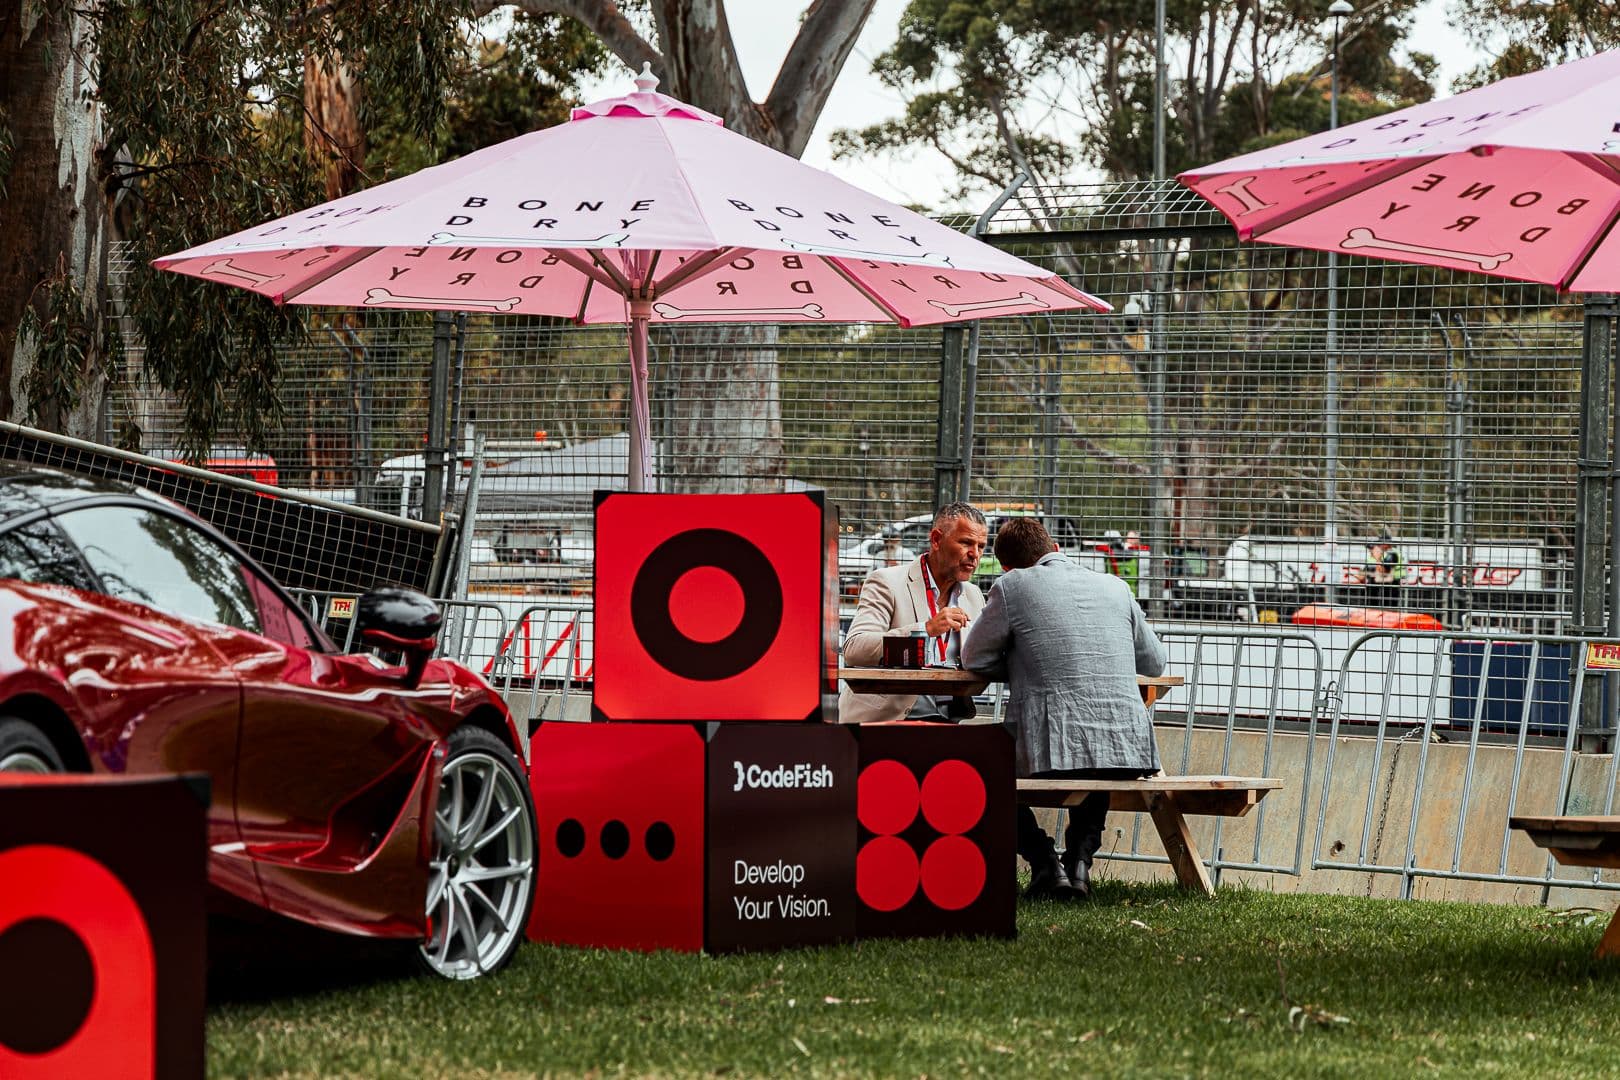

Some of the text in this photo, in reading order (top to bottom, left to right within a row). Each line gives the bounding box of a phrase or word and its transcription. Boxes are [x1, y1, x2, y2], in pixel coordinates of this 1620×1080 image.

[463, 196, 655, 211] BONE
[727, 198, 901, 228] BONE
[446, 215, 641, 229] DRY
[753, 219, 922, 247] DRY
[746, 763, 834, 788] CodeFish
[734, 859, 805, 888] Develop
[733, 894, 831, 920] Your Vision.
